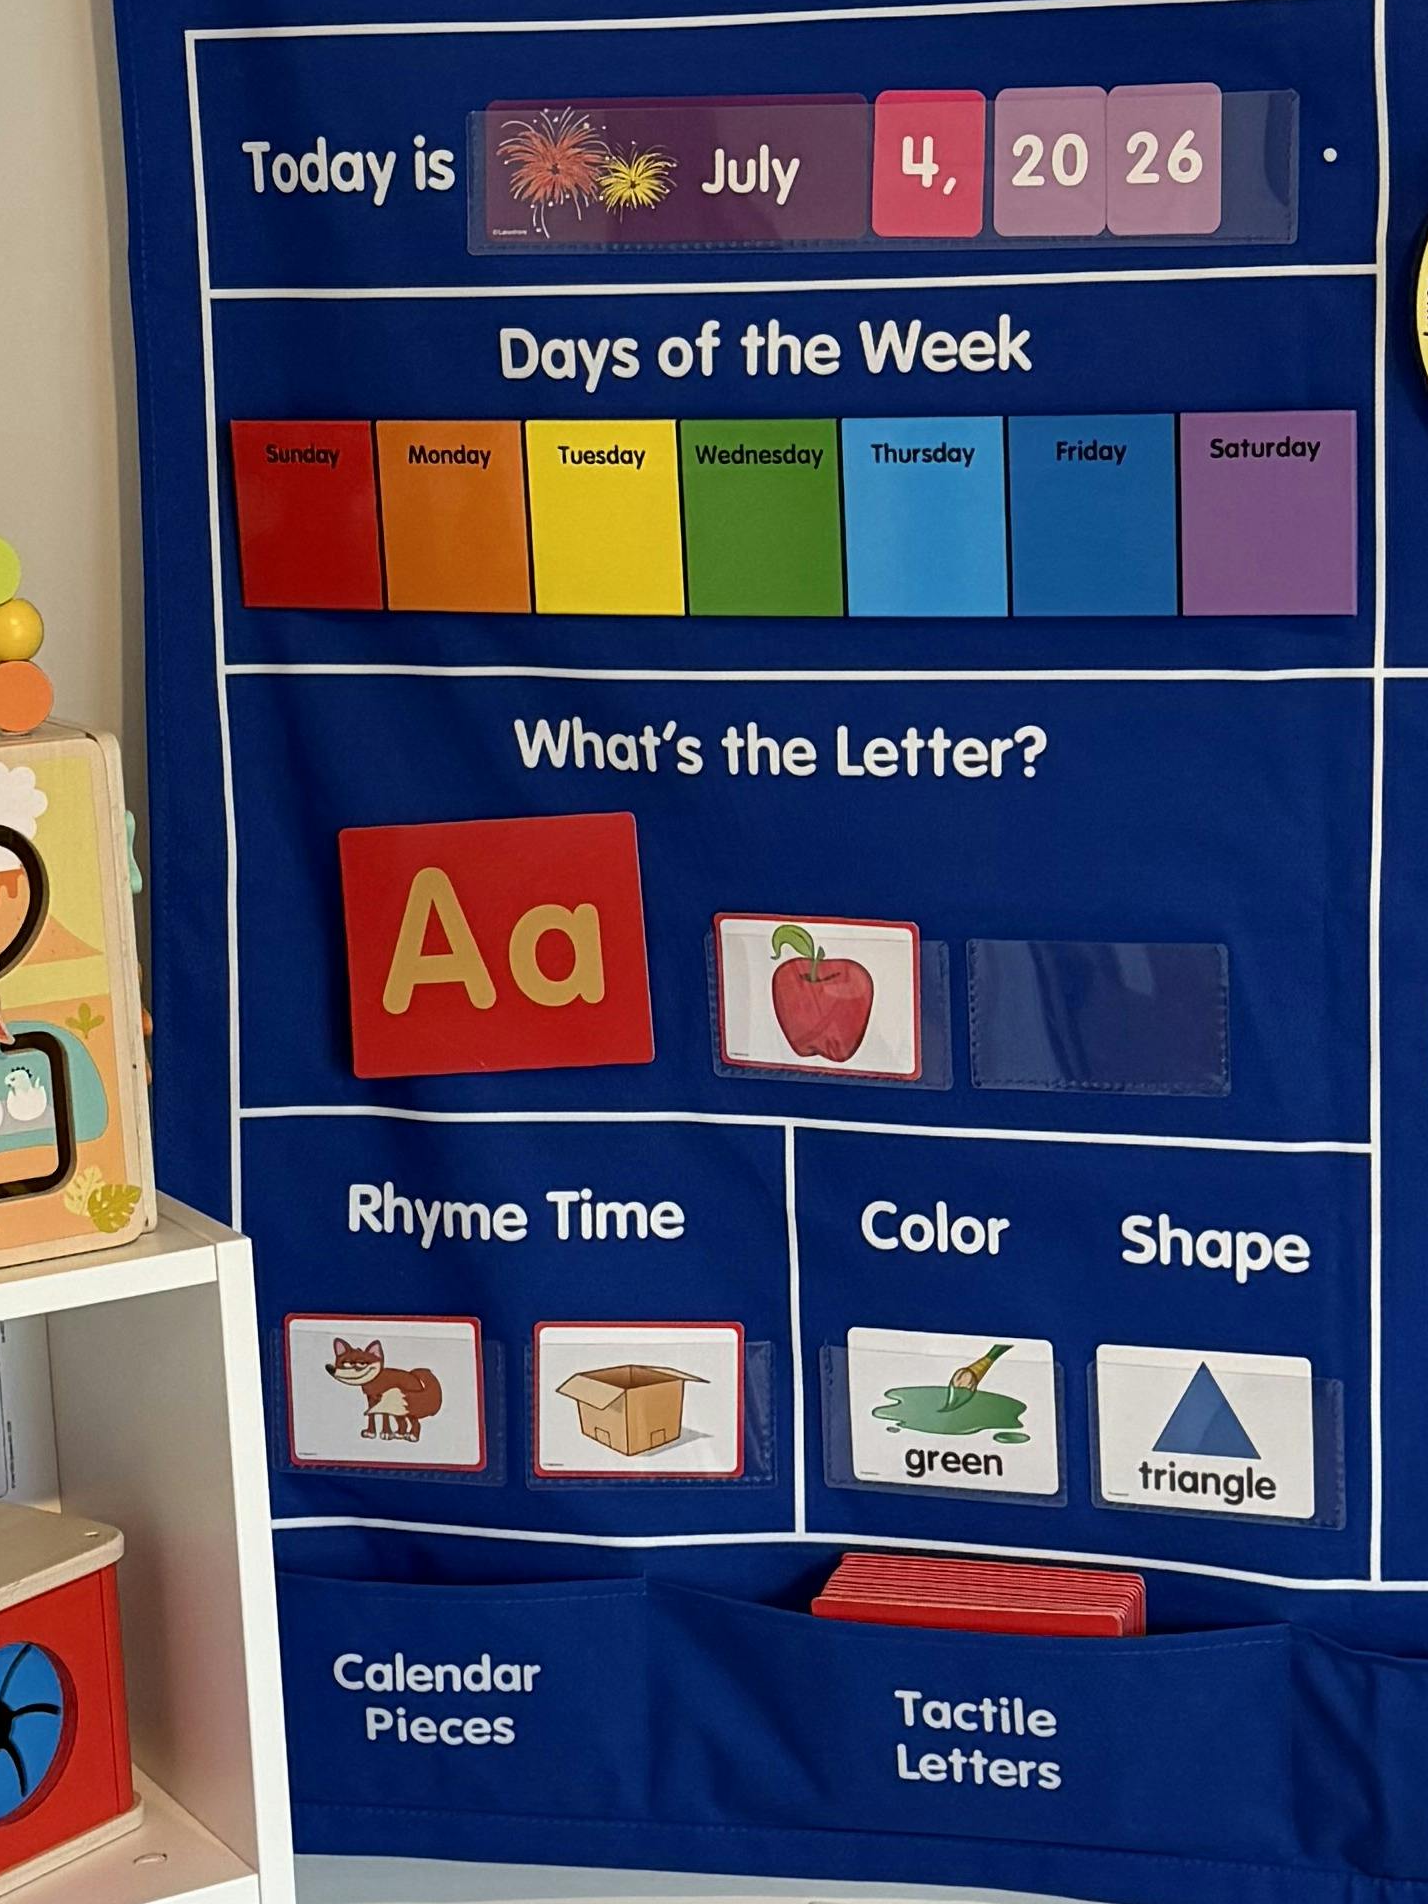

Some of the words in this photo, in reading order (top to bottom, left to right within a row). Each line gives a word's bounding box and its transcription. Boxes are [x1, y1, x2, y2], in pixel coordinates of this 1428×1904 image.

[242, 137, 396, 206] Today
[414, 135, 455, 190] is
[702, 145, 800, 205] July
[903, 136, 956, 194] 4,
[1012, 134, 1088, 186] 20
[1126, 130, 1202, 183] 26
[500, 328, 639, 393] Days
[658, 320, 720, 377] of
[741, 319, 840, 375] the
[859, 314, 1032, 373] Week
[266, 444, 339, 468] Sunday
[409, 445, 491, 469] Monday
[558, 445, 645, 469] Tuesday
[696, 444, 823, 469] Wednesday
[871, 442, 975, 467] Thursday
[1057, 440, 1126, 465] Friday
[1211, 436, 1320, 462] Saturday
[514, 717, 703, 774] What's
[722, 722, 816, 776] the
[837, 726, 1047, 777] Letter?
[383, 867, 604, 1014] Aa
[349, 1182, 527, 1248] Rhyme
[546, 1188, 684, 1239] Time
[862, 1201, 1010, 1254] Color
[1122, 1214, 1310, 1283] Shape
[904, 1445, 1004, 1478] green
[1138, 1460, 1277, 1506] triangle
[334, 1653, 541, 1692] Calendar
[366, 1707, 515, 1745] Pieces
[895, 1690, 1056, 1737] Tactile
[897, 1744, 1061, 1789] Letters
